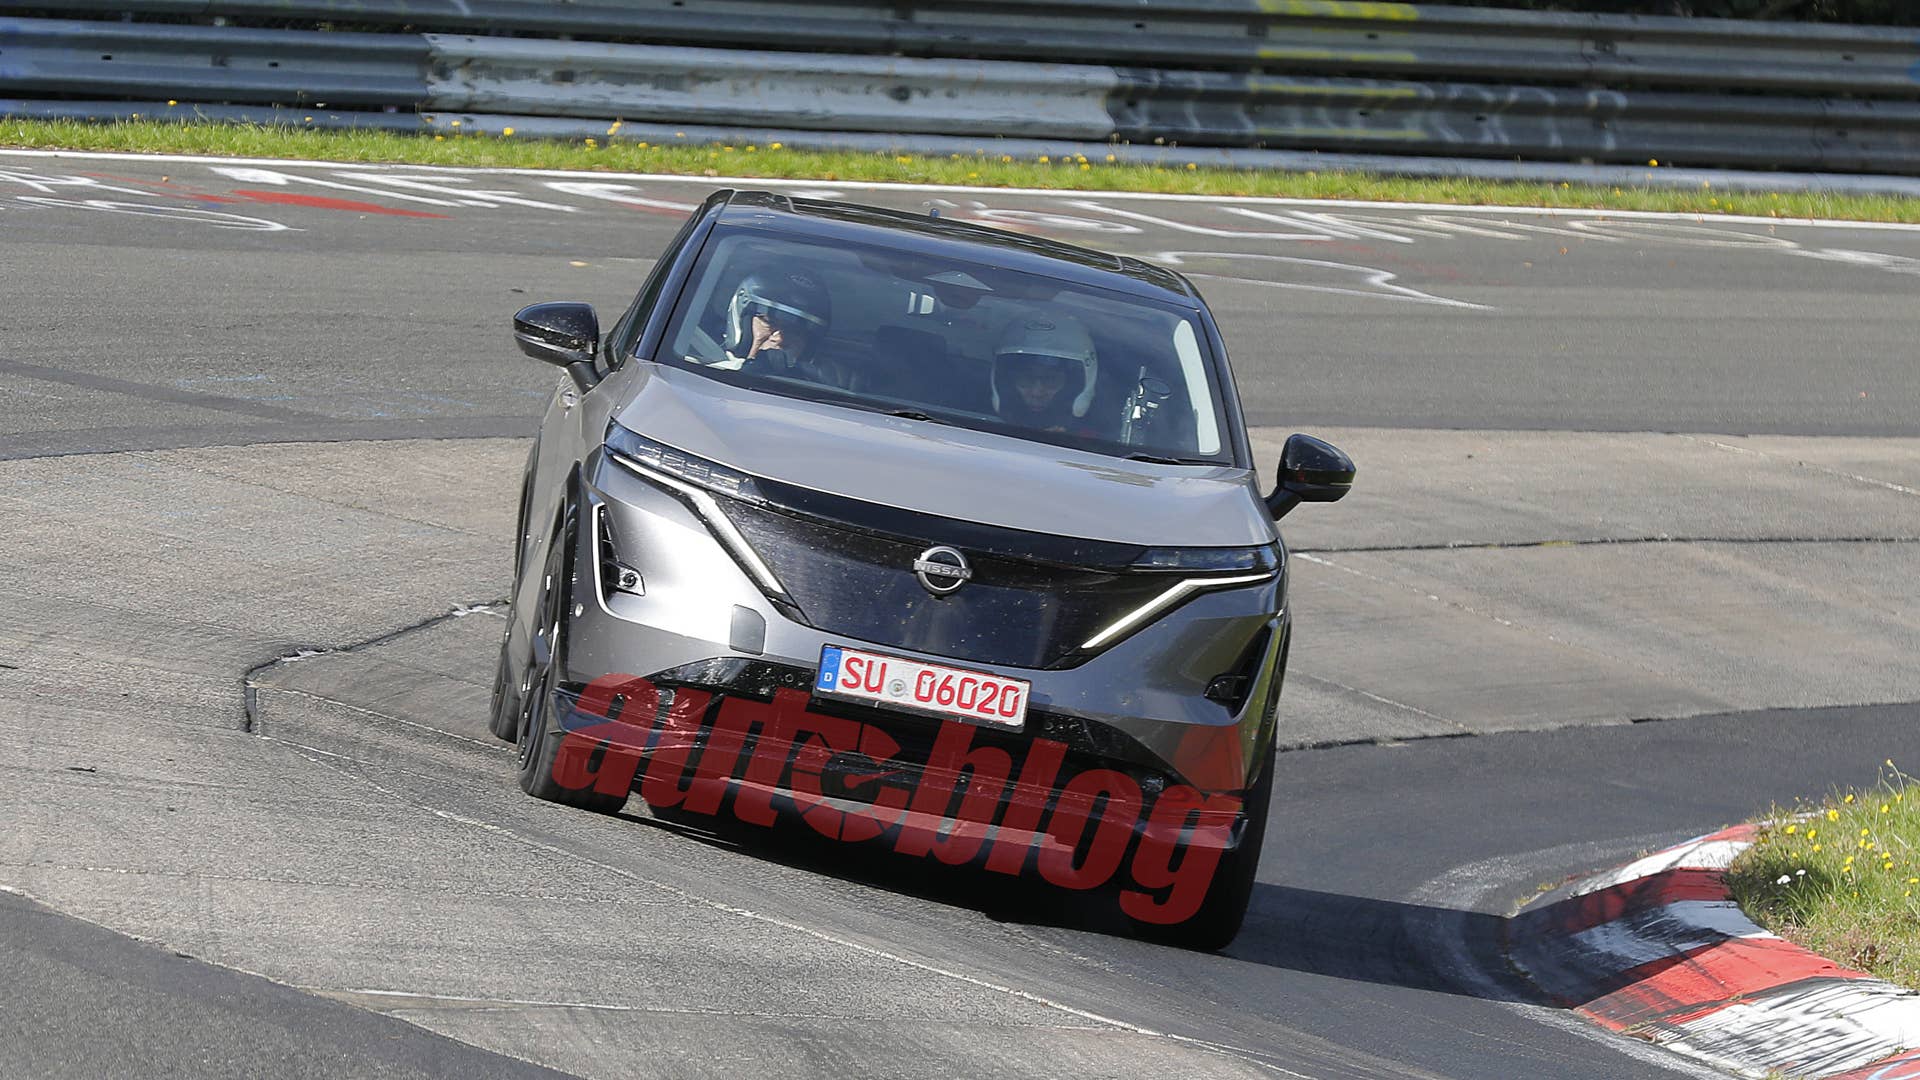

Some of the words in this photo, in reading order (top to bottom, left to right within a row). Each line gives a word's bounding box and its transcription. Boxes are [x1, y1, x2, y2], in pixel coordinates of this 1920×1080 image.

[914, 560, 973, 579] NISSAN
[840, 656, 887, 694] SU
[914, 669, 1021, 719] 06020
